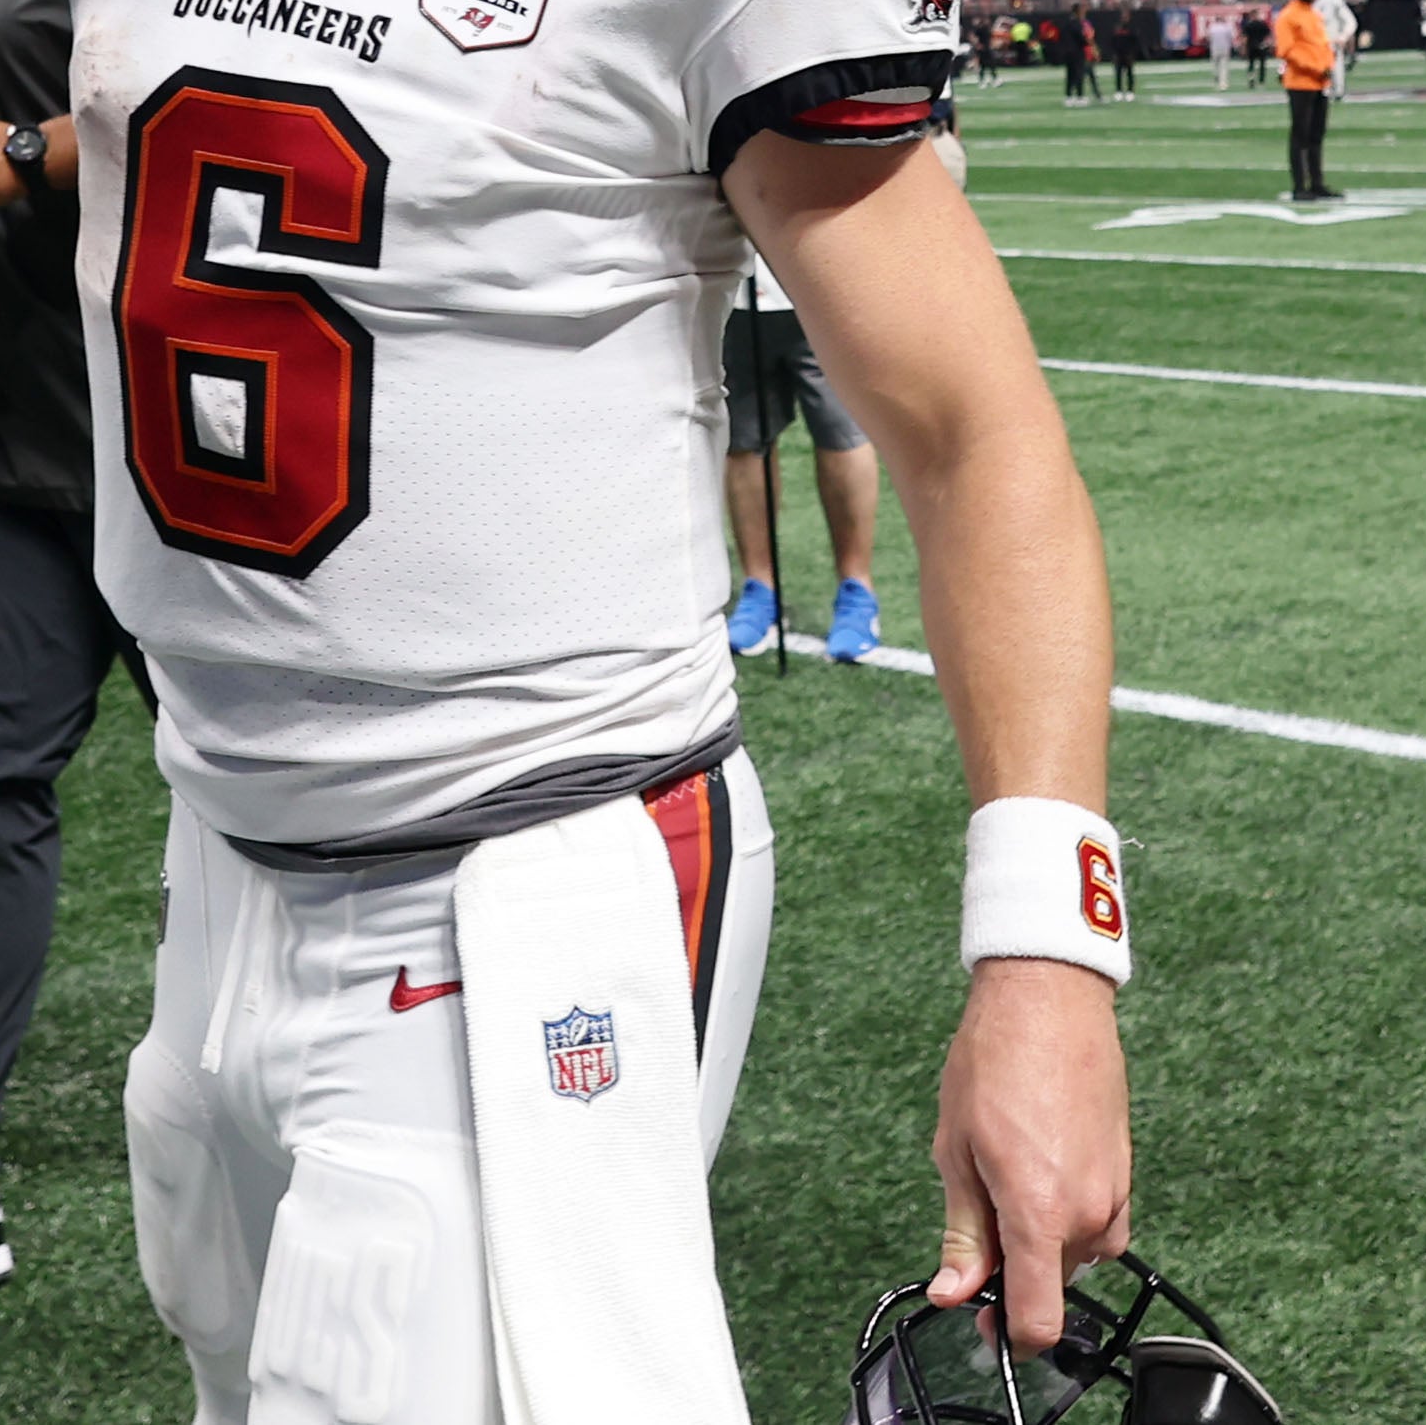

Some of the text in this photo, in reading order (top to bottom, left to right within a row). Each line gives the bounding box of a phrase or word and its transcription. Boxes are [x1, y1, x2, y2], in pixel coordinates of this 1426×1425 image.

[112, 64, 390, 580] 6
[1076, 835, 1123, 942] 6
[553, 1046, 614, 1093] NFL
